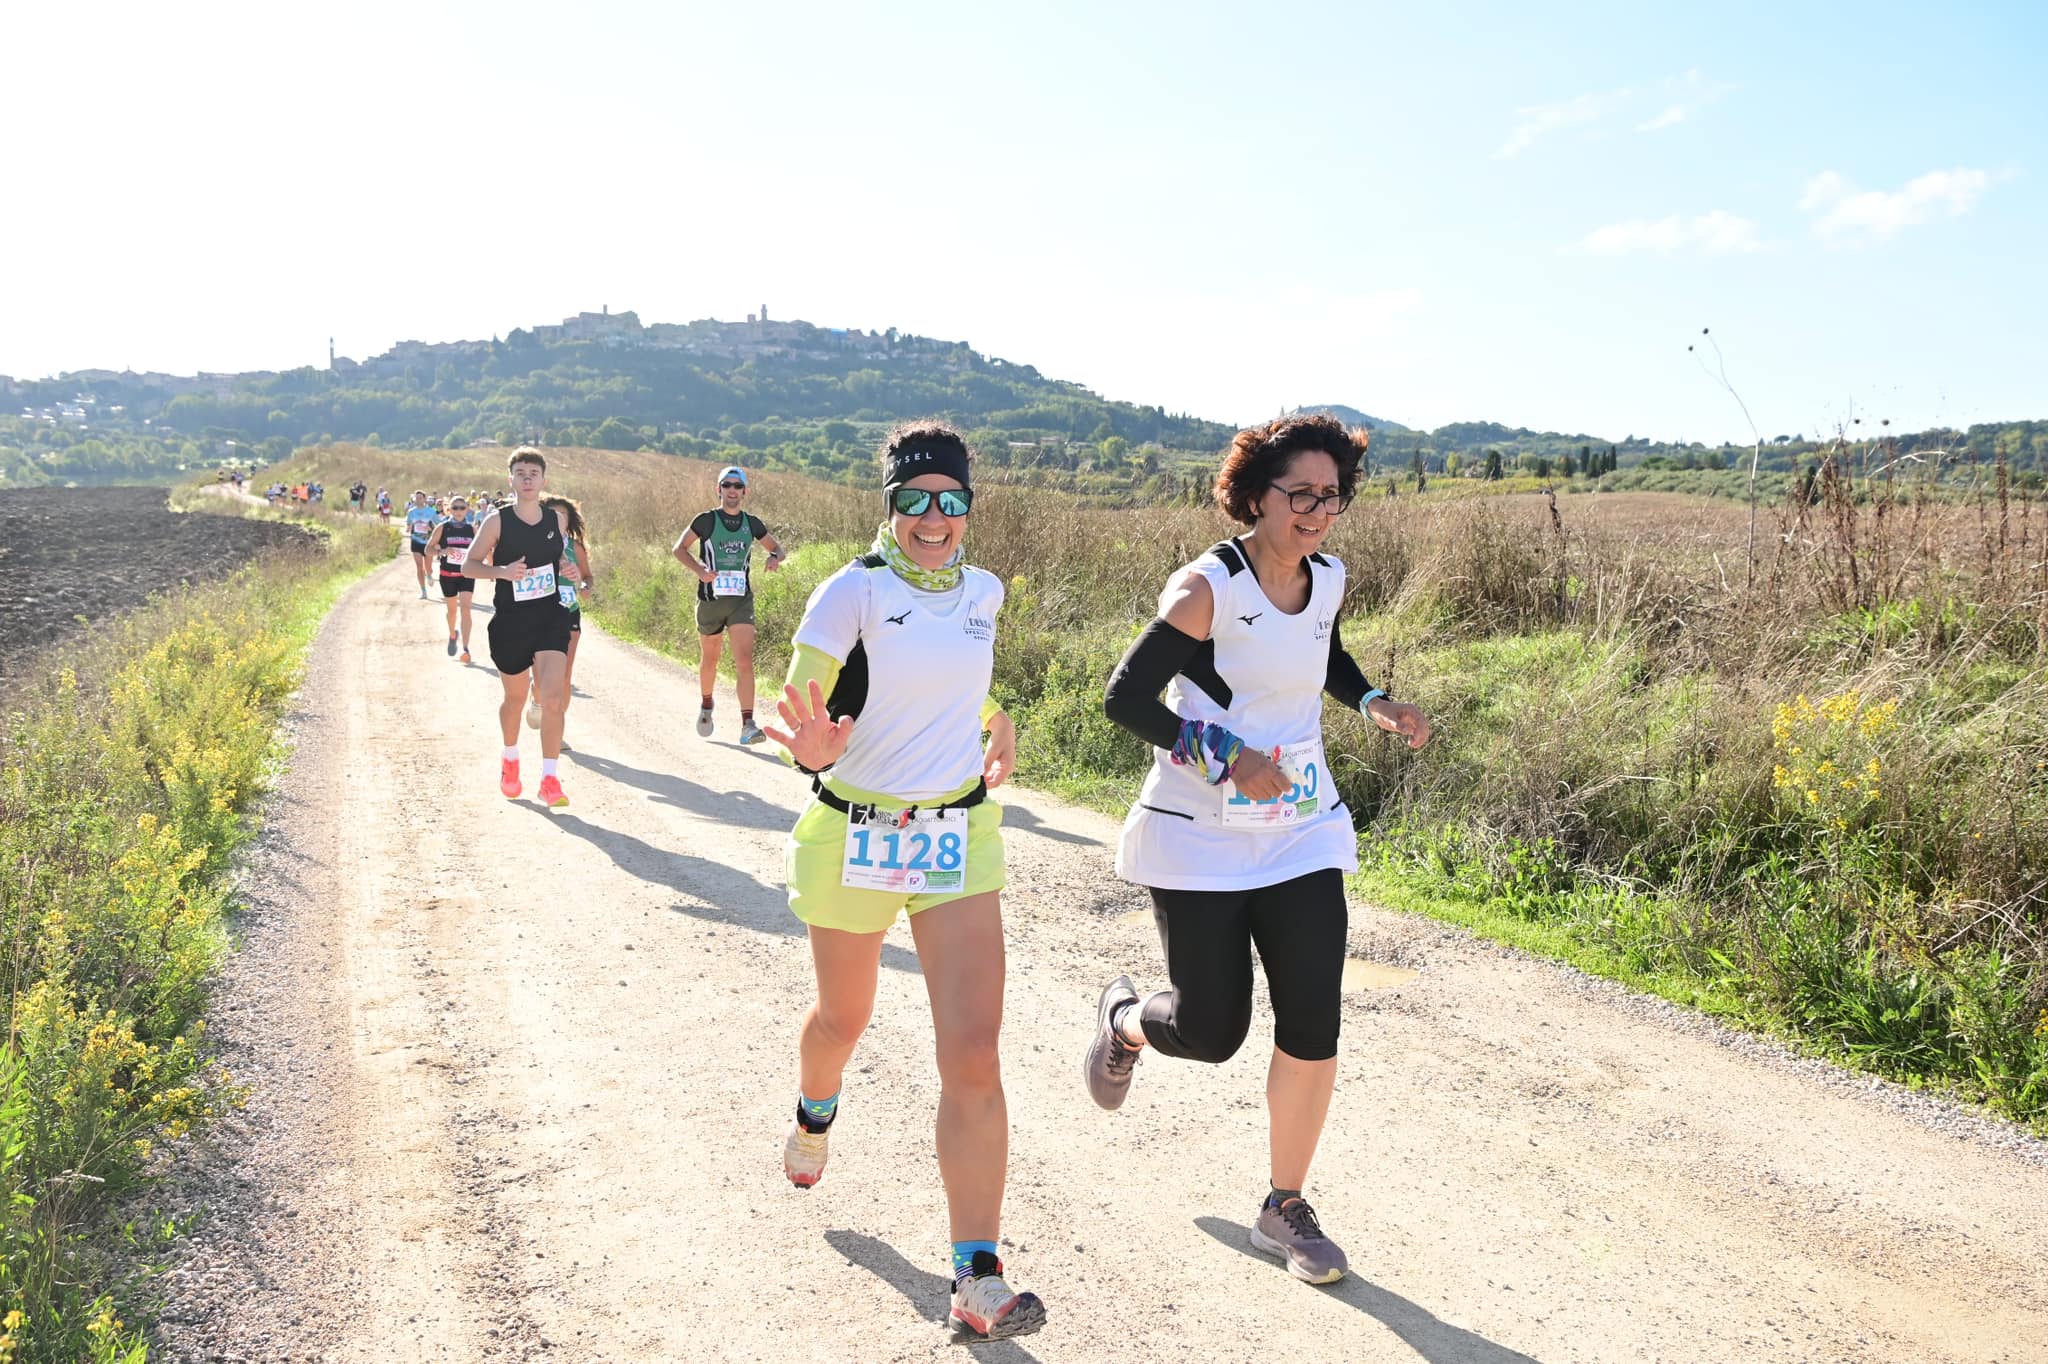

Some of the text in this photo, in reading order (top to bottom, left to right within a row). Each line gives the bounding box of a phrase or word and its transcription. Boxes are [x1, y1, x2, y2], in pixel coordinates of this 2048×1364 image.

[516, 573, 554, 592] 1279
[716, 577, 745, 589] 1179
[1228, 763, 1317, 805] 30
[849, 829, 961, 870] 1128
